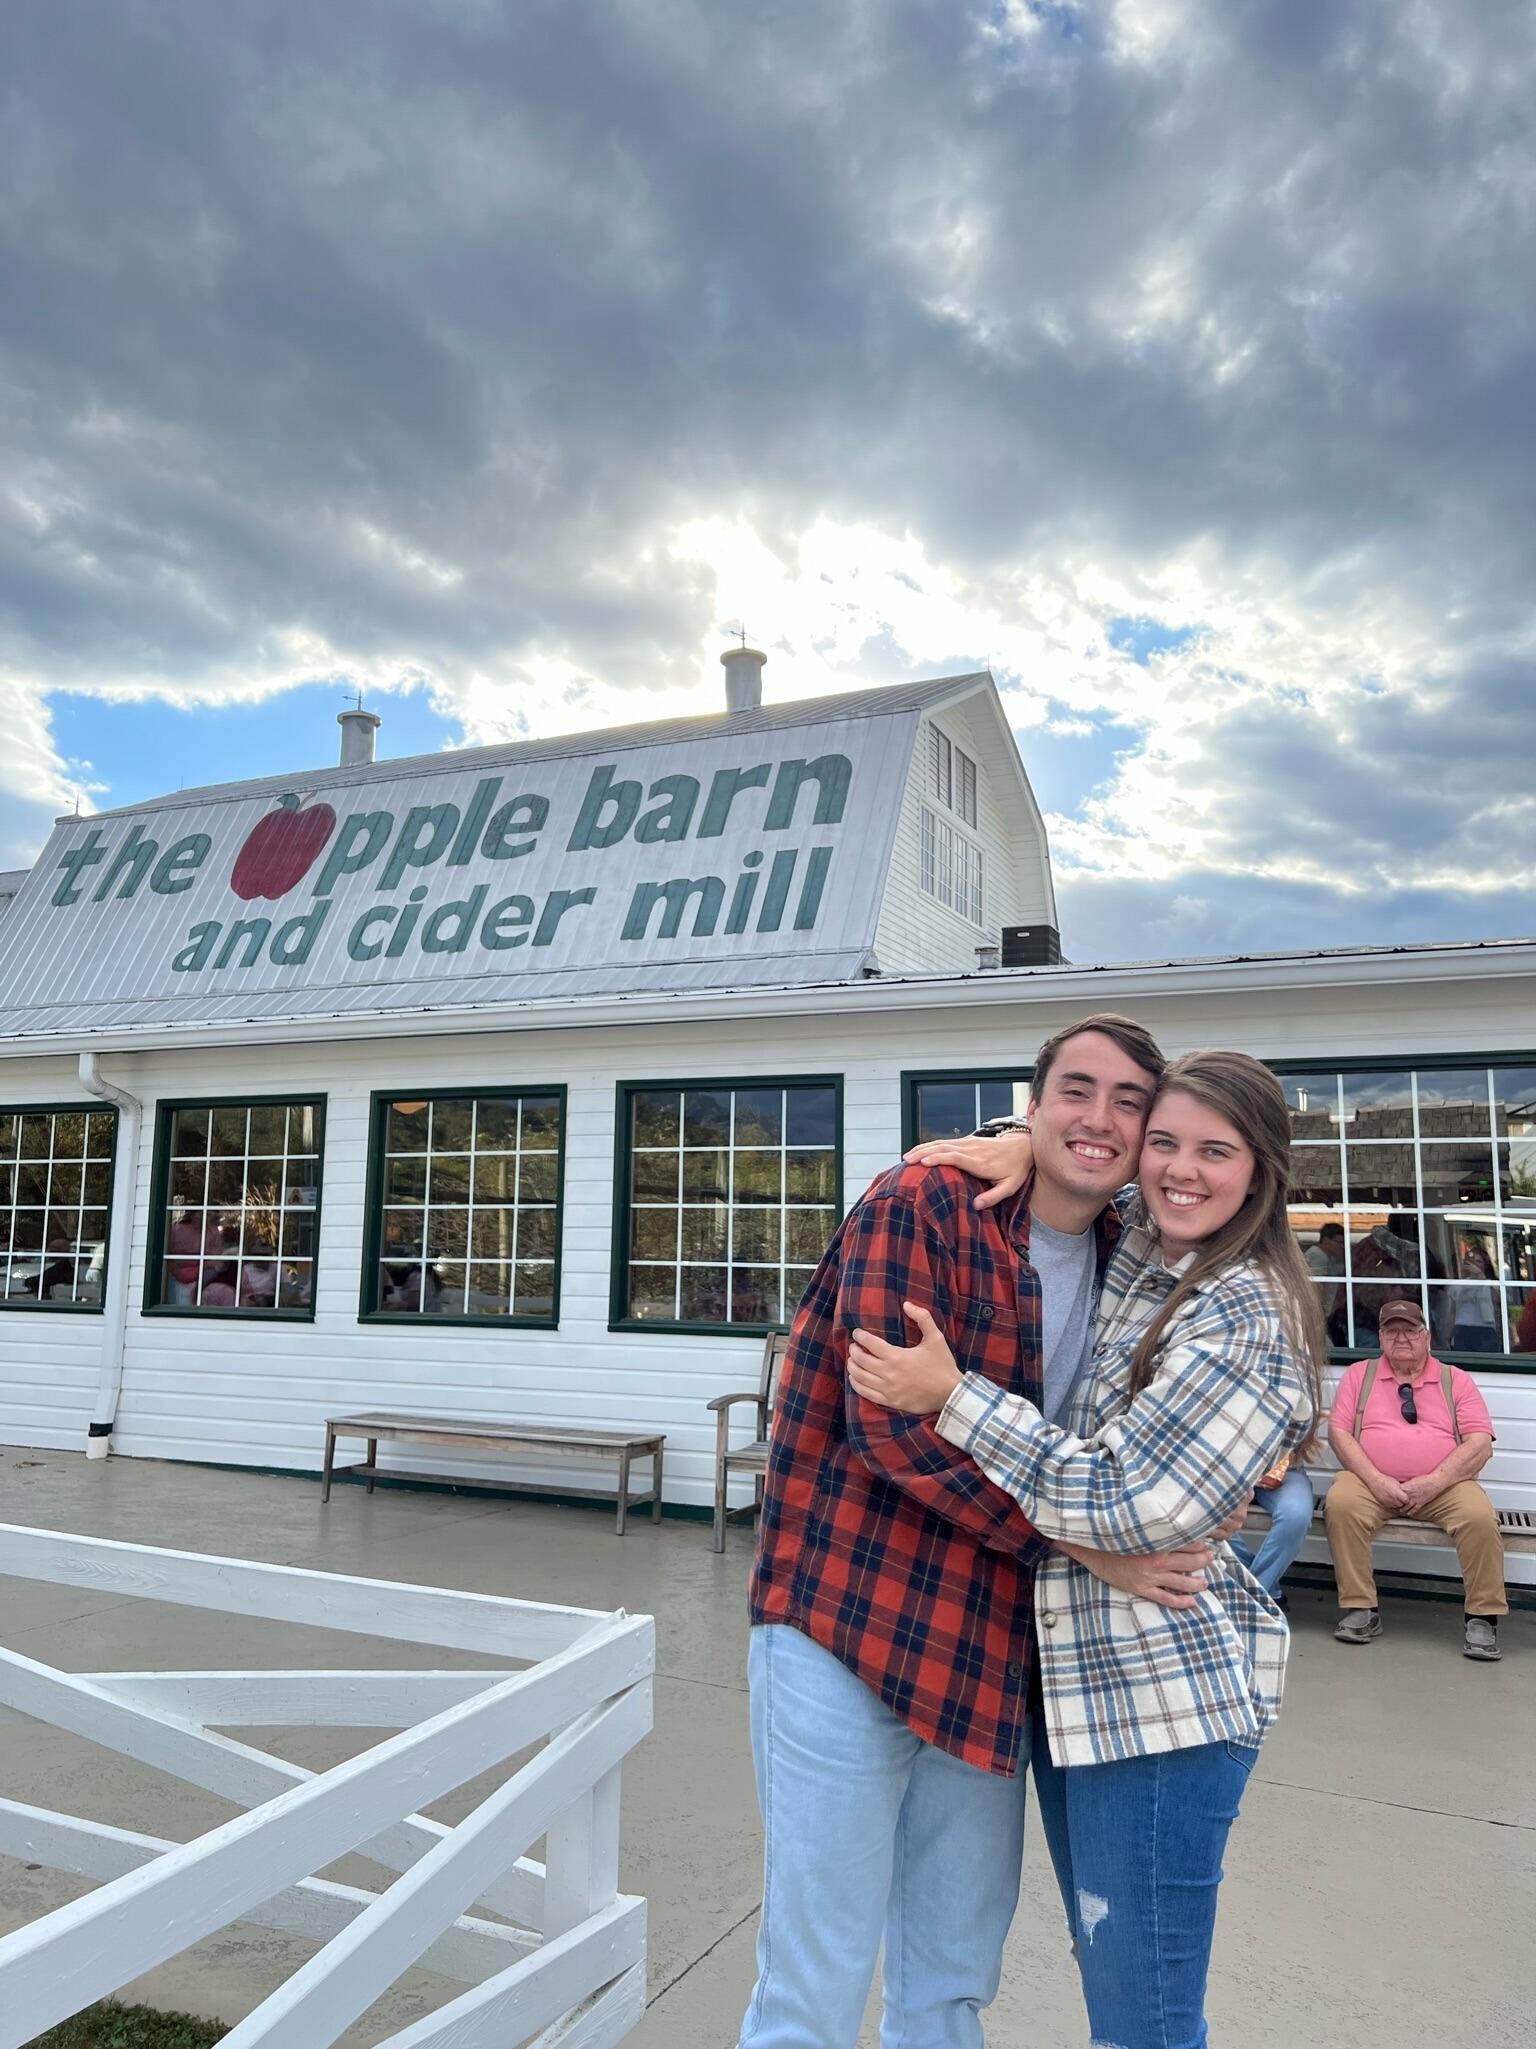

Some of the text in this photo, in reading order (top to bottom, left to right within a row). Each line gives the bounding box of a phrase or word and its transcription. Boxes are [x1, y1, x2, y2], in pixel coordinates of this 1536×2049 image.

[51, 824, 212, 907] the
[566, 753, 853, 852] barn
[171, 846, 834, 972] and cider mill
